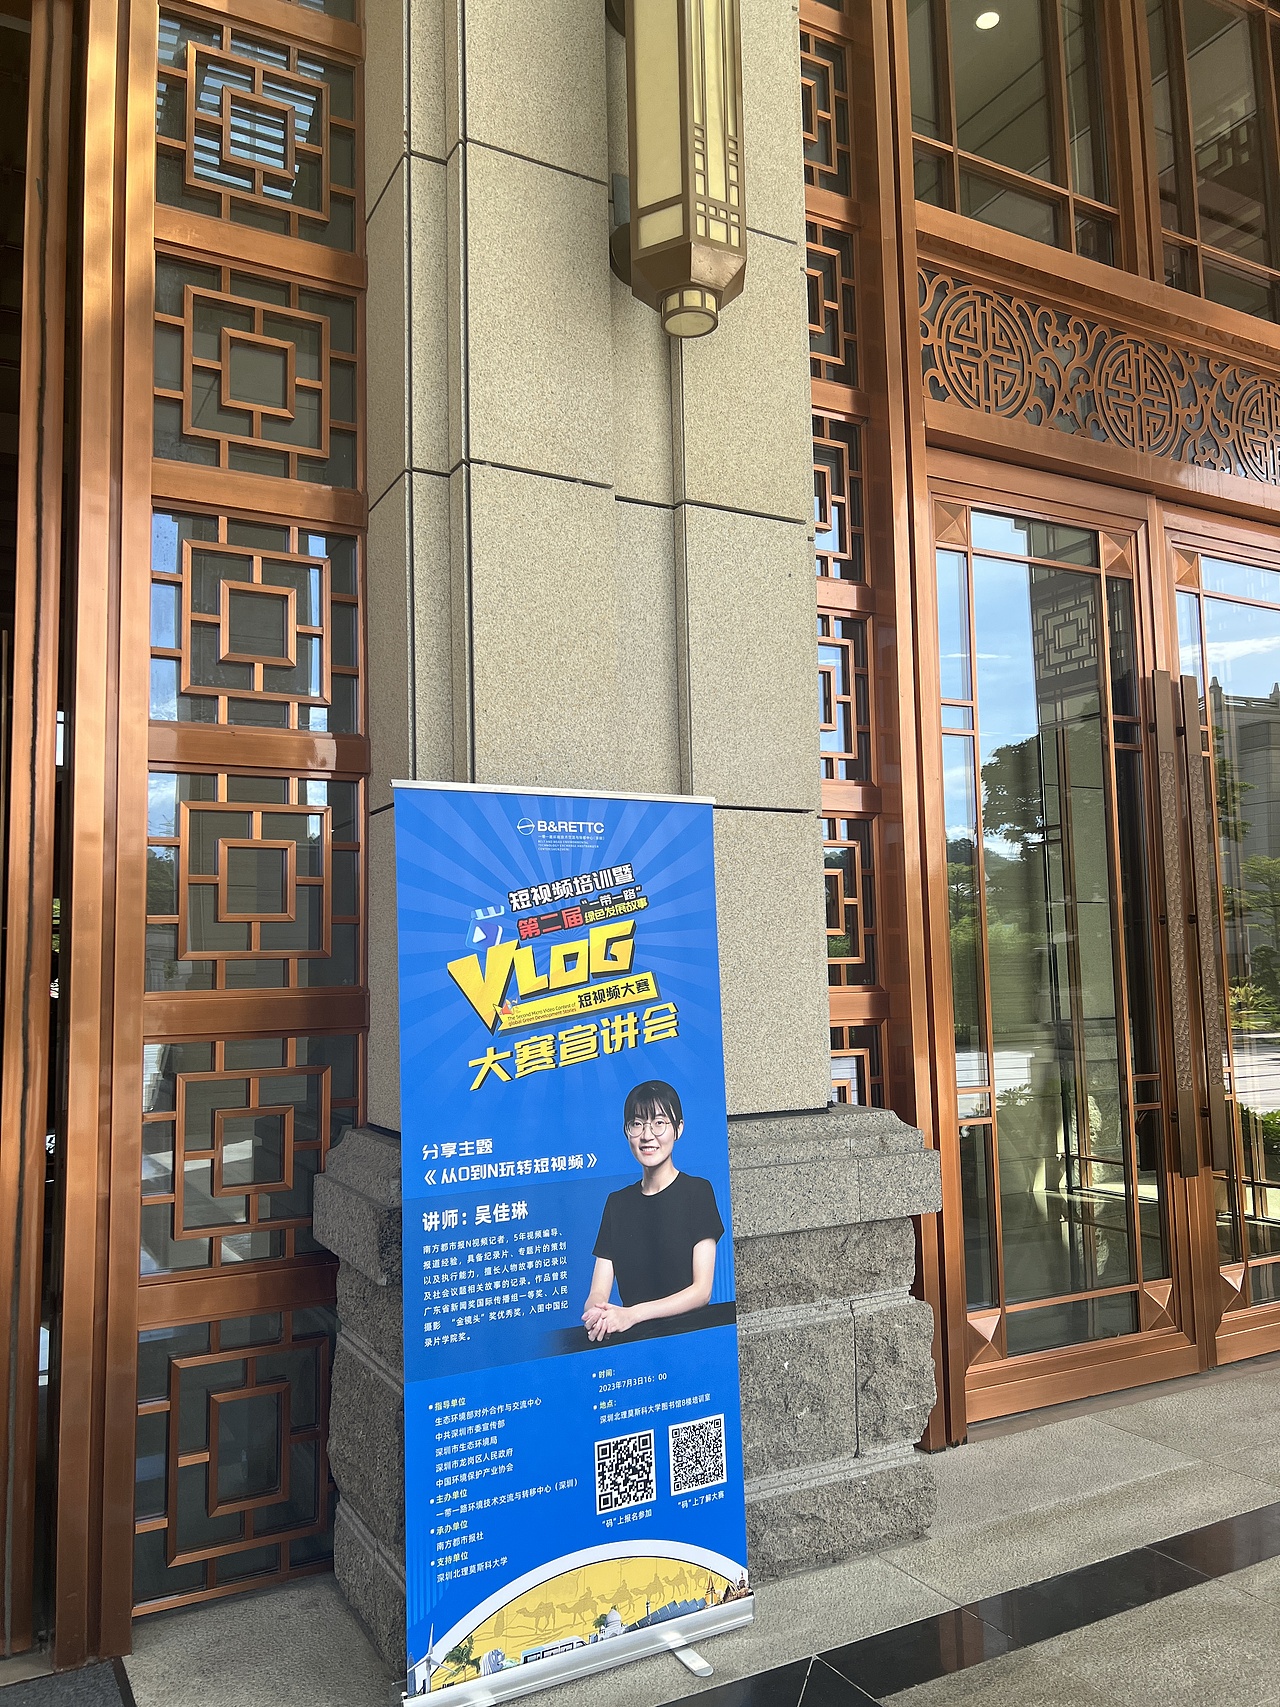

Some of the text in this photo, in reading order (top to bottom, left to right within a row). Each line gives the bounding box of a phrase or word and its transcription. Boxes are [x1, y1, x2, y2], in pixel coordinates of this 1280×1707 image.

[538, 820, 604, 834] B&RETTC
[508, 863, 635, 912] 短视频培训暨
[518, 906, 584, 940] 第二届
[584, 898, 648, 924] 绿色发展故事
[447, 920, 636, 1033] VLOG
[578, 978, 650, 1008] 短视频大赛
[468, 1002, 679, 1091] 大赛宣讲会
[422, 1138, 493, 1160] 分享主题
[422, 1200, 529, 1232] 讲师：吴佳琳
[424, 1332, 471, 1348] 录片学院奖。
[434, 1397, 466, 1411] 指导单位
[435, 1397, 542, 1426] 生态环境部对外合作与交流中心
[435, 1419, 506, 1442] 中共深圳市委宣传部
[435, 1436, 498, 1457] 深圳市生态环境局
[435, 1448, 514, 1473] 深圳市龙岗区人民政府
[436, 1463, 514, 1488] 中国环境保护产业协会
[436, 1488, 468, 1504] 主办单位
[436, 1520, 468, 1536] 承办单位
[436, 1531, 484, 1551] 南方都市报社
[436, 1551, 469, 1568] 支持单位
[436, 1556, 508, 1583] 深圳北理莫斯科大学
